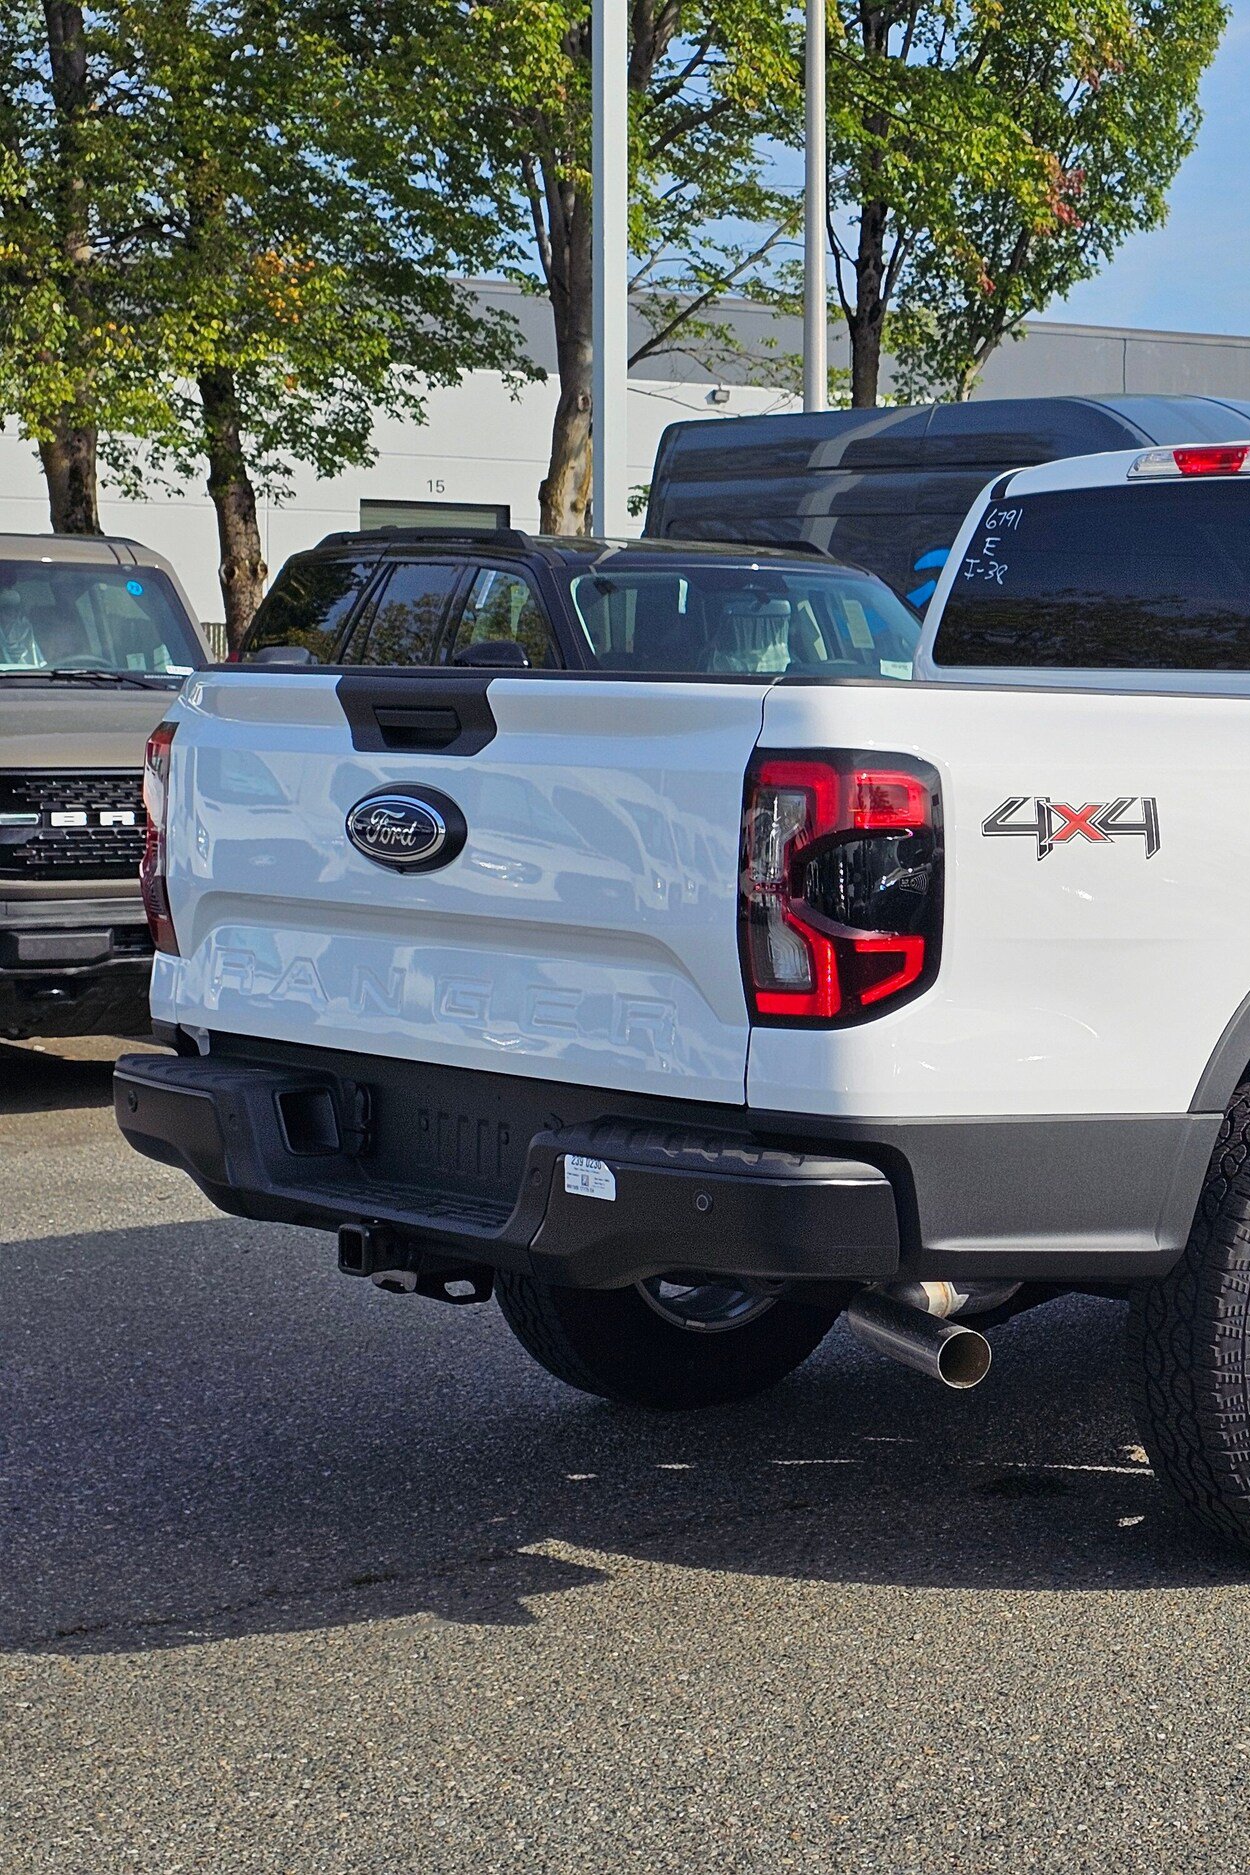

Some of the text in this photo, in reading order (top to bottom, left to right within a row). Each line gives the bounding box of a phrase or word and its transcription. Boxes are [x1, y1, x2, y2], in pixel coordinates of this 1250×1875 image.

[426, 479, 445, 494] 15
[985, 508, 1023, 531] 6791
[983, 537, 1001, 556] E
[366, 808, 417, 847] Ford
[204, 946, 678, 1072] RANGER
